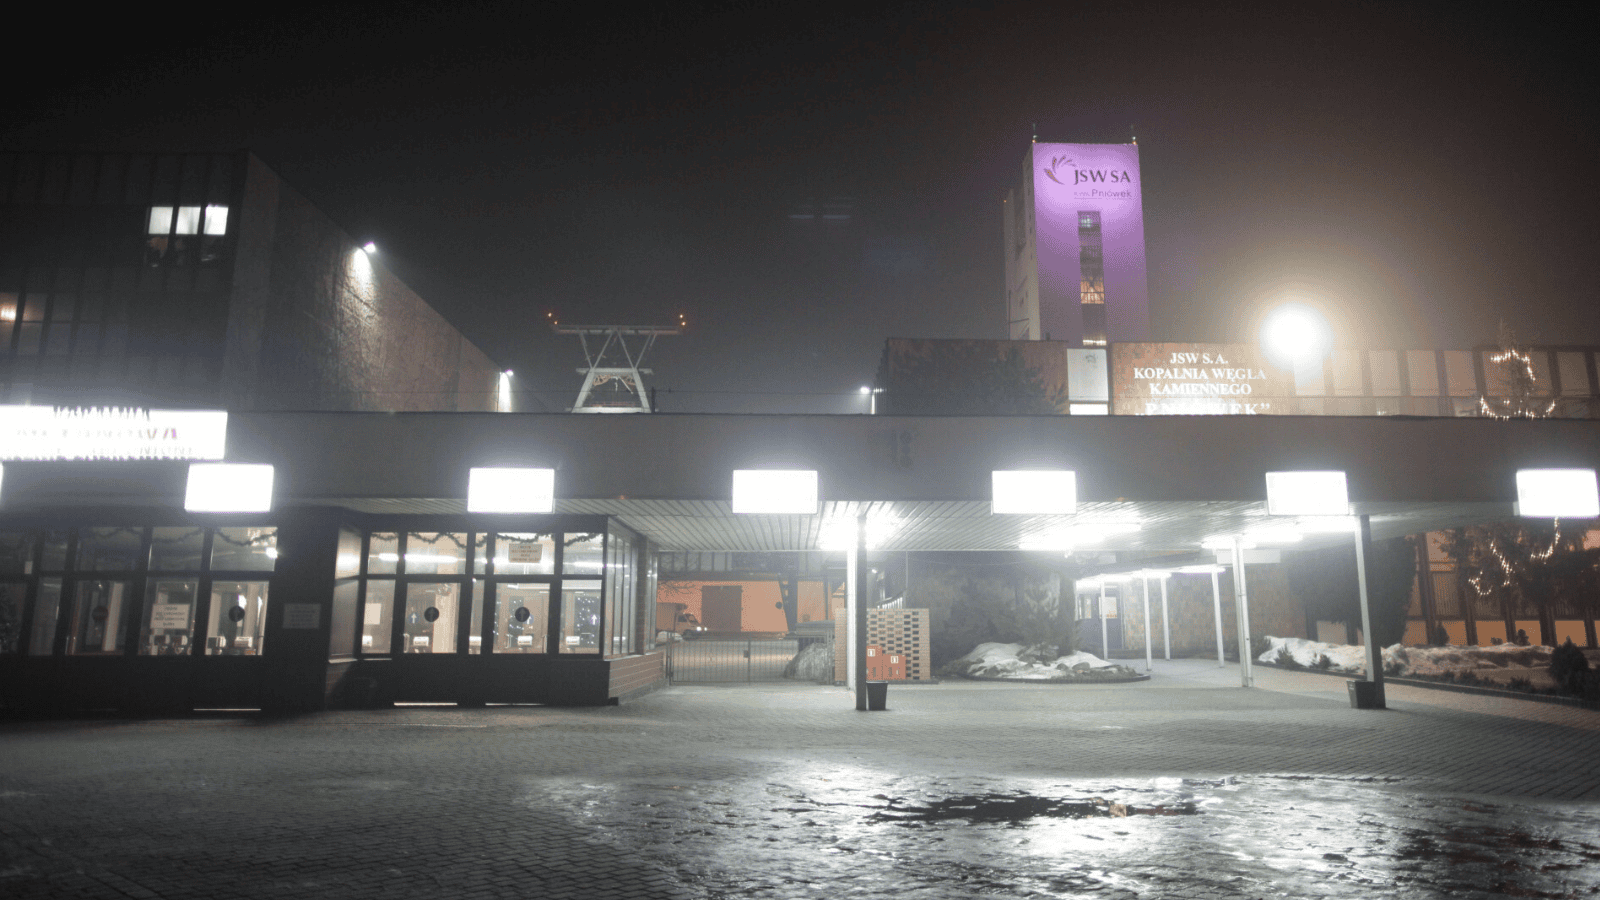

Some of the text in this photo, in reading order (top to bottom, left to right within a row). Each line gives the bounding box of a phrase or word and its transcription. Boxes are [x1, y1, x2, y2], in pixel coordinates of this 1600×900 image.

[1073, 169, 1131, 185] JSW SA
[1091, 188, 1132, 198] Pniówek
[1170, 352, 1199, 364] JSW
[1134, 368, 1266, 382] KOPALNIA WĘGLA
[1149, 383, 1252, 395] KAMIENNEGO
